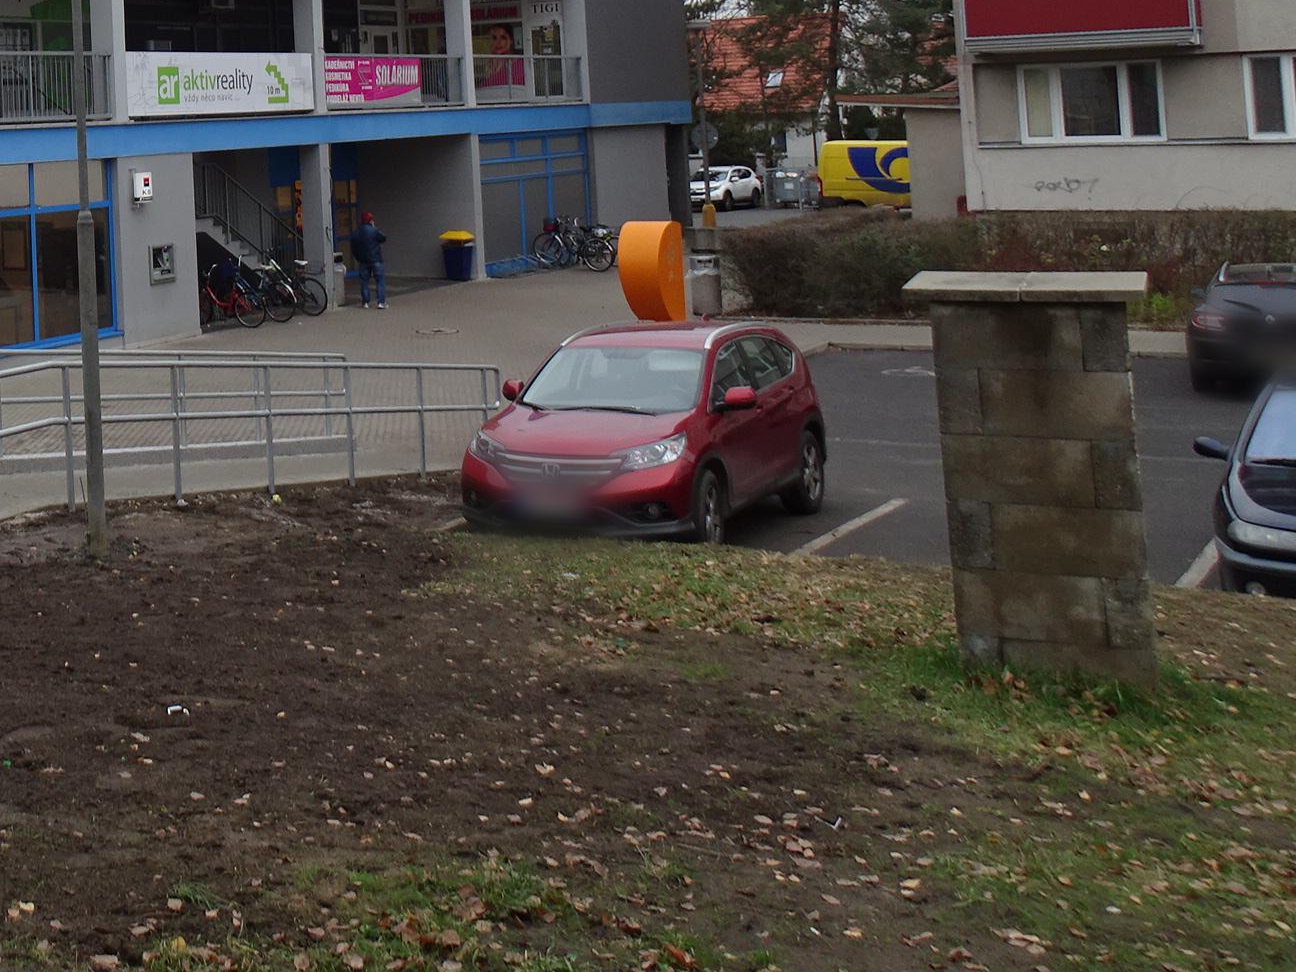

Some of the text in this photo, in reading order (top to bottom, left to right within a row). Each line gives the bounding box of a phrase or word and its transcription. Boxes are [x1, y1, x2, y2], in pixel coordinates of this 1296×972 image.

[183, 67, 254, 95] aktivreality
[375, 60, 419, 86] SOLÁRIUM
[159, 74, 179, 99] ar
[267, 85, 274, 96] 10
